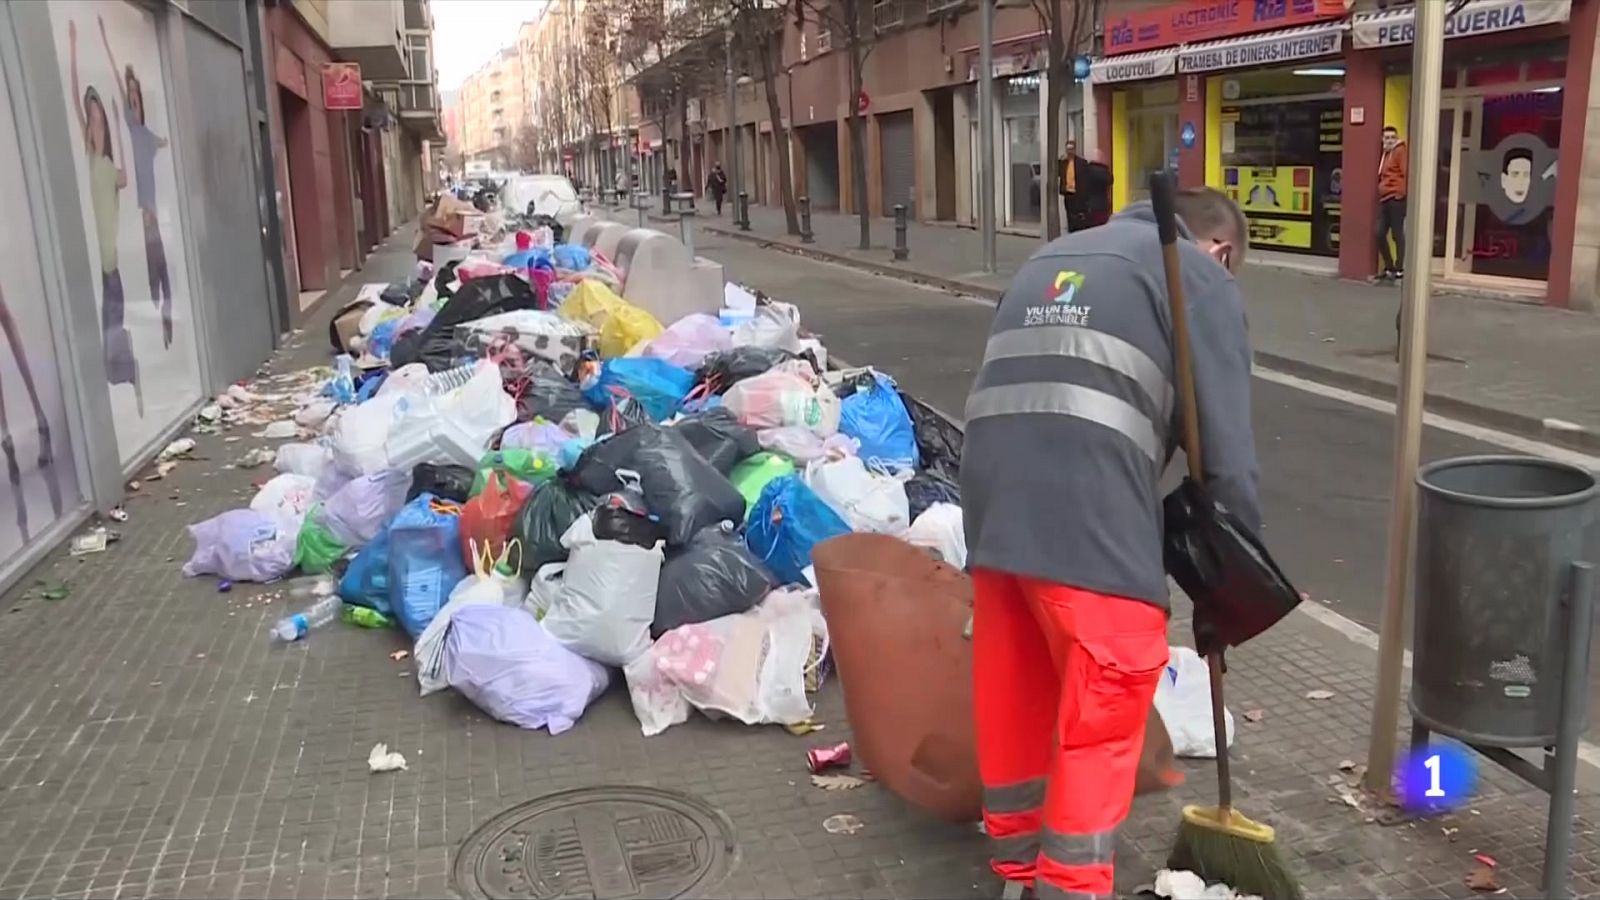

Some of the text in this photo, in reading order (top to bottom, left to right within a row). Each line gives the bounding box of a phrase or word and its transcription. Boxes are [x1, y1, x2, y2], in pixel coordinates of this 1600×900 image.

[1172, 2, 1239, 27] LACTRONIC
[1378, 4, 1526, 44] PERQUERIA
[1181, 53, 1222, 70] TRAMESA
[1225, 49, 1238, 65] DE
[1106, 60, 1155, 80] LOCUTORI
[1023, 314, 1089, 326] SOSTENIBLE
[1026, 304, 1091, 316] VIU UN SALT
